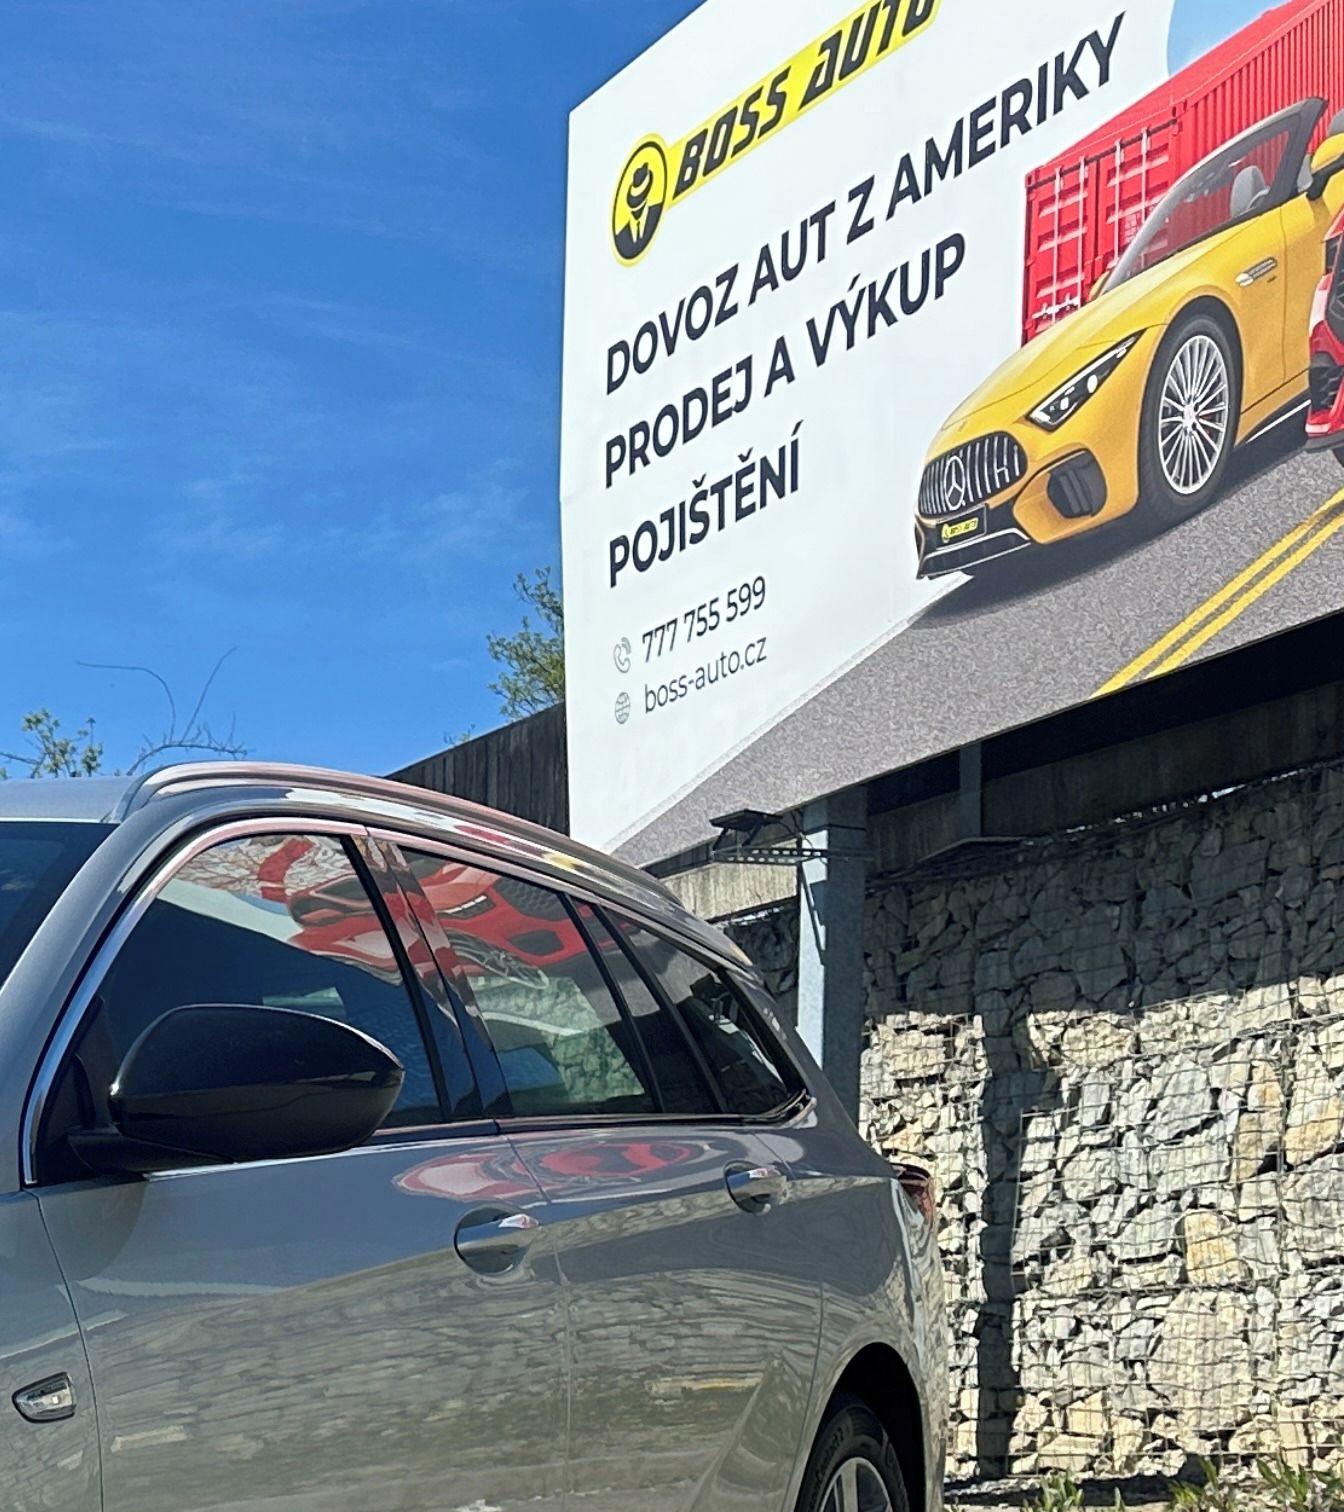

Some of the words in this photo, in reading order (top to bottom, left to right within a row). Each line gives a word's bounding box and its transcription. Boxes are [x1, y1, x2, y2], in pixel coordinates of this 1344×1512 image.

[606, 263, 739, 395] DOVOZ
[748, 200, 836, 306] AUT
[846, 175, 875, 245] Z
[886, 11, 1126, 221] AMERIKY
[672, 65, 791, 200] BOSS
[606, 354, 752, 489] PRODEJ
[764, 335, 795, 398] A
[806, 233, 965, 368] VÝKUP
[609, 419, 804, 588] POJIŠTĚNÍ
[642, 618, 678, 663] 777
[683, 597, 720, 643] 755
[726, 576, 766, 623] 599
[645, 637, 768, 713] boss-auto.cz
